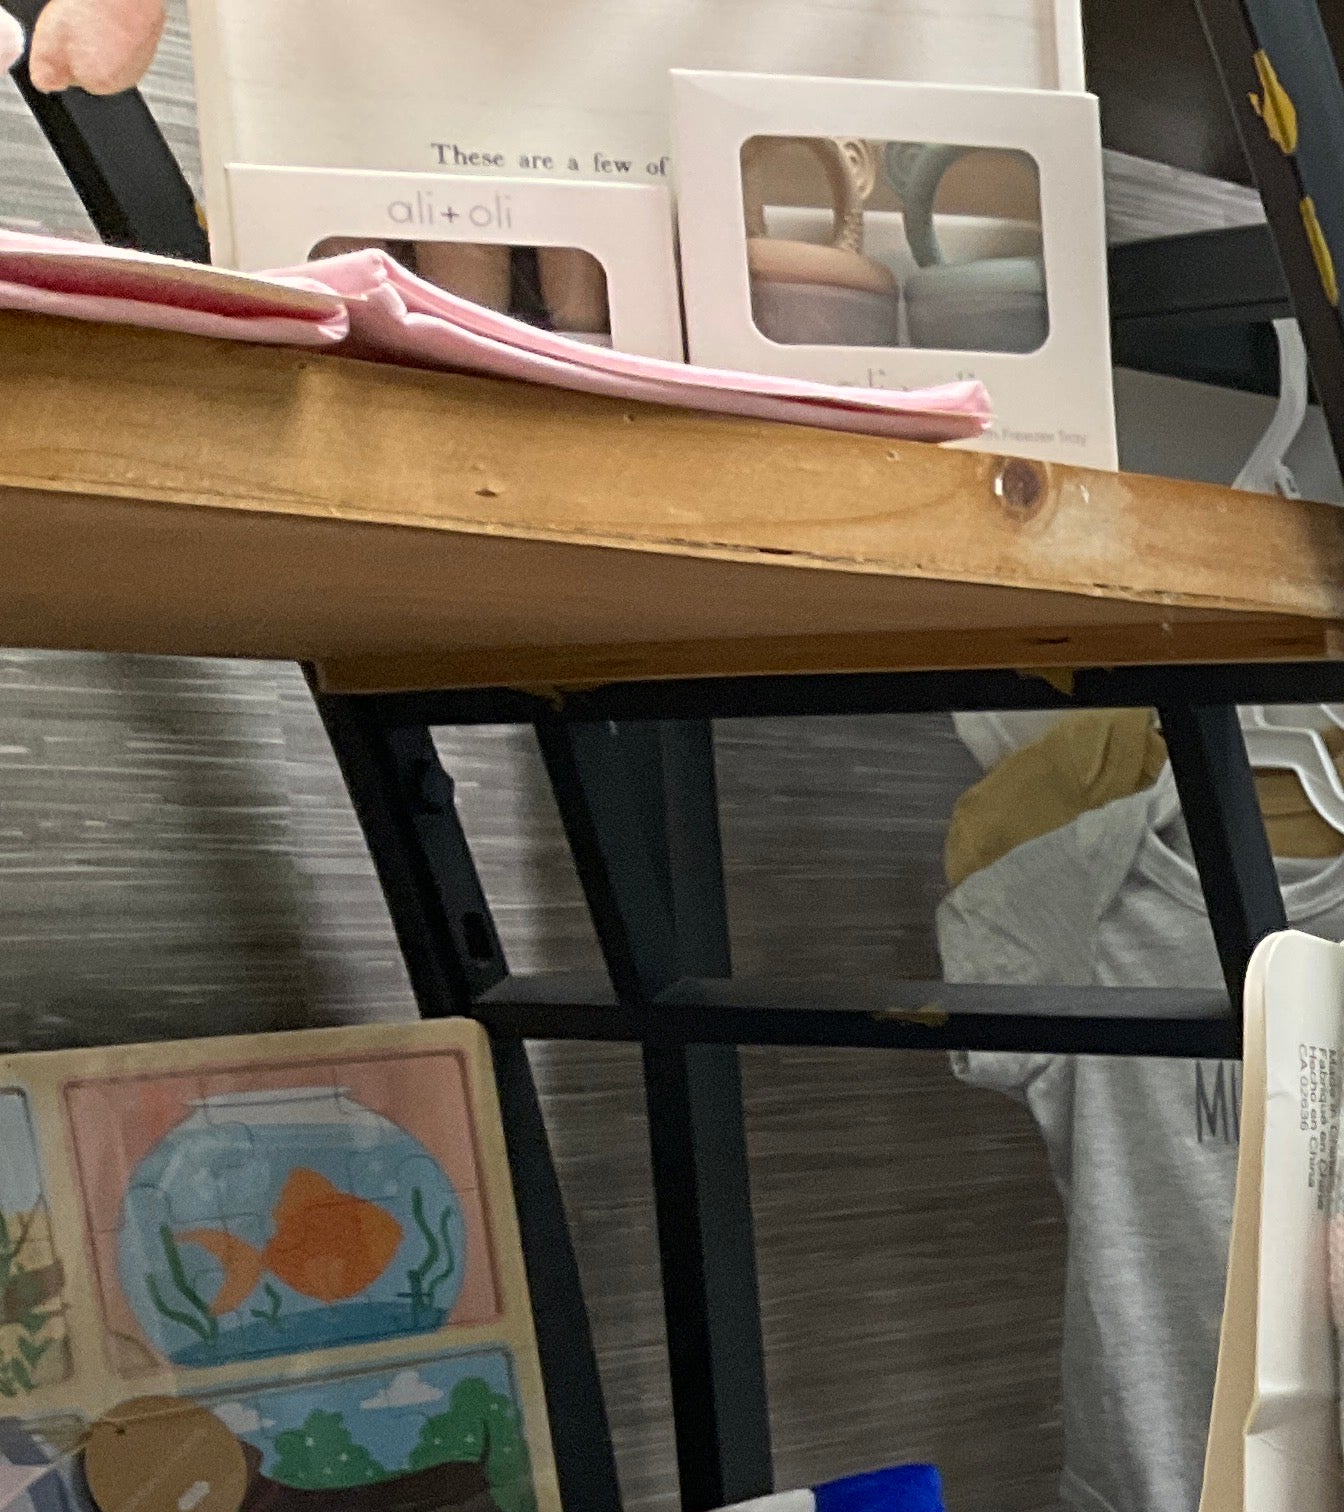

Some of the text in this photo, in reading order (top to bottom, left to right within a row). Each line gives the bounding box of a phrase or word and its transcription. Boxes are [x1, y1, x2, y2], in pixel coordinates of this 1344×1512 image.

[431, 143, 670, 176] These are a few of
[1308, 1045, 1319, 1103] Hecho
